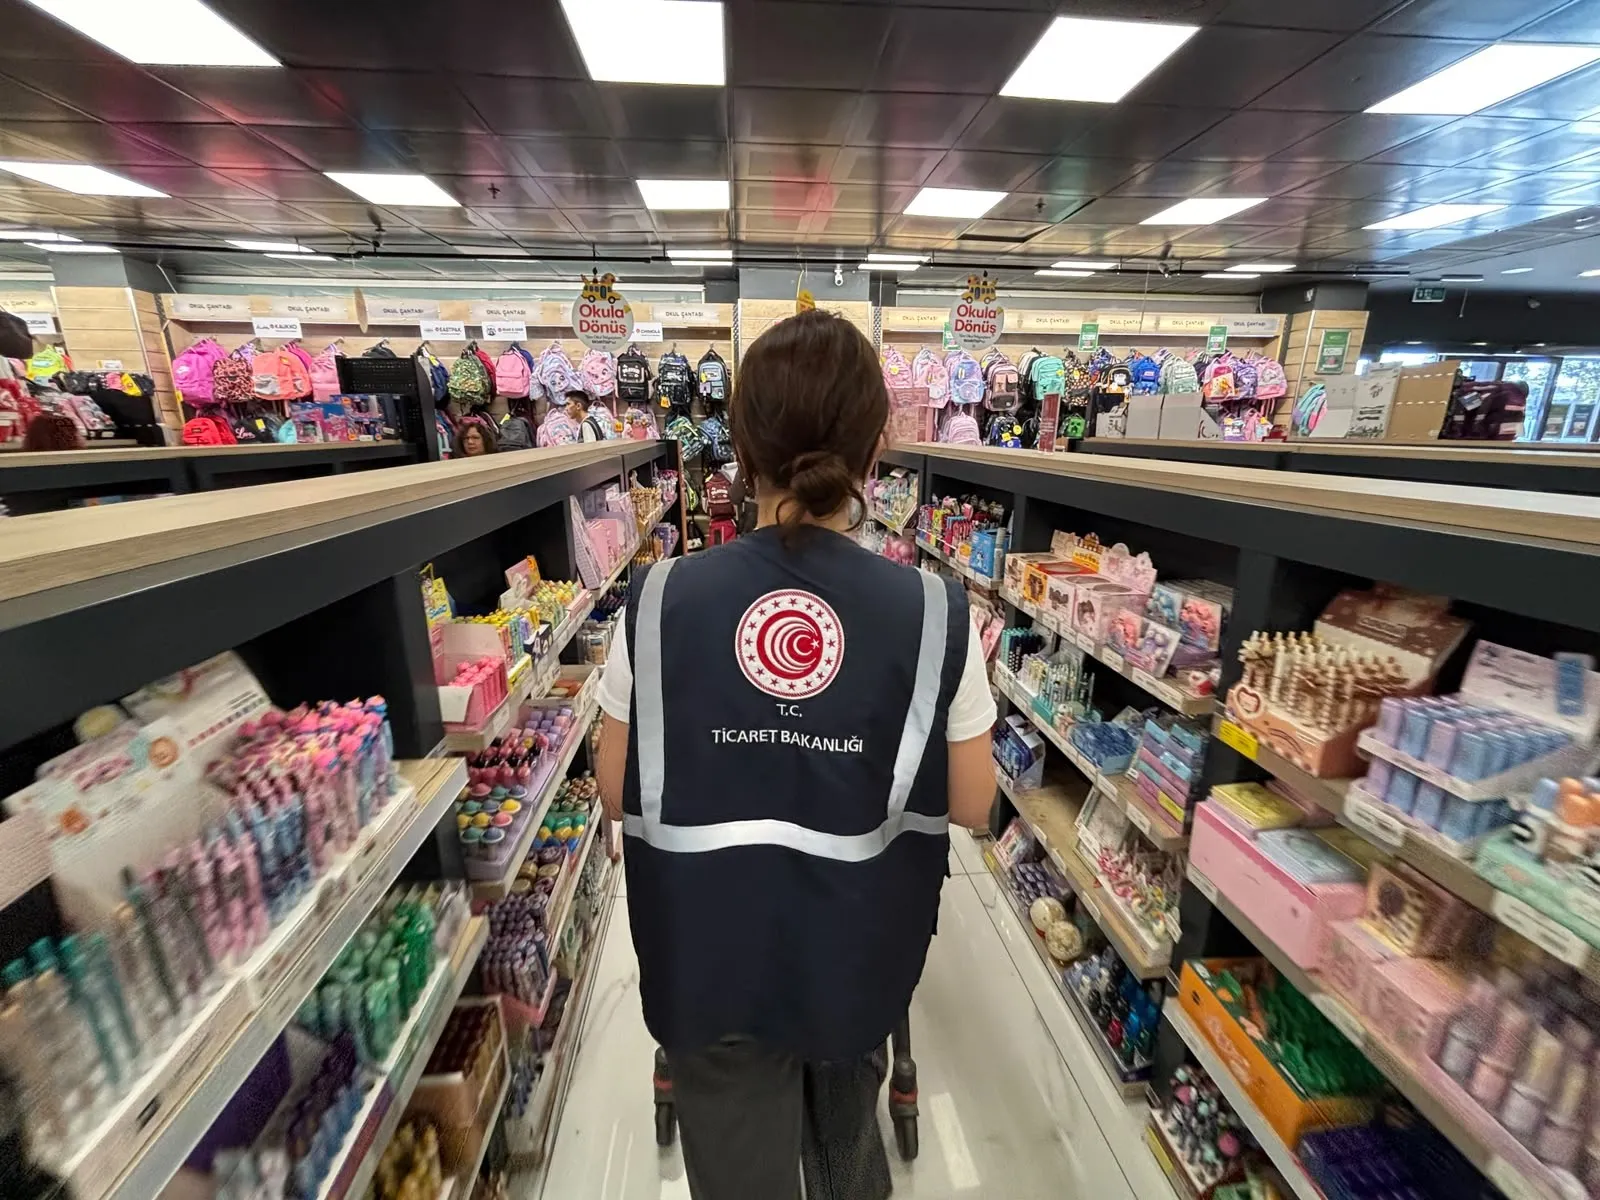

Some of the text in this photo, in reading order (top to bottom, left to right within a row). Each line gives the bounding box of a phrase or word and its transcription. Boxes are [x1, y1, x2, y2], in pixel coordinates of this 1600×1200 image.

[579, 304, 625, 319] Okula
[956, 304, 997, 319] Okula
[579, 320, 627, 337] Dönüş
[954, 319, 997, 336] Dönüş
[775, 703, 803, 718] T.C.
[711, 727, 863, 753] TİCARET BAKANLIĞI
